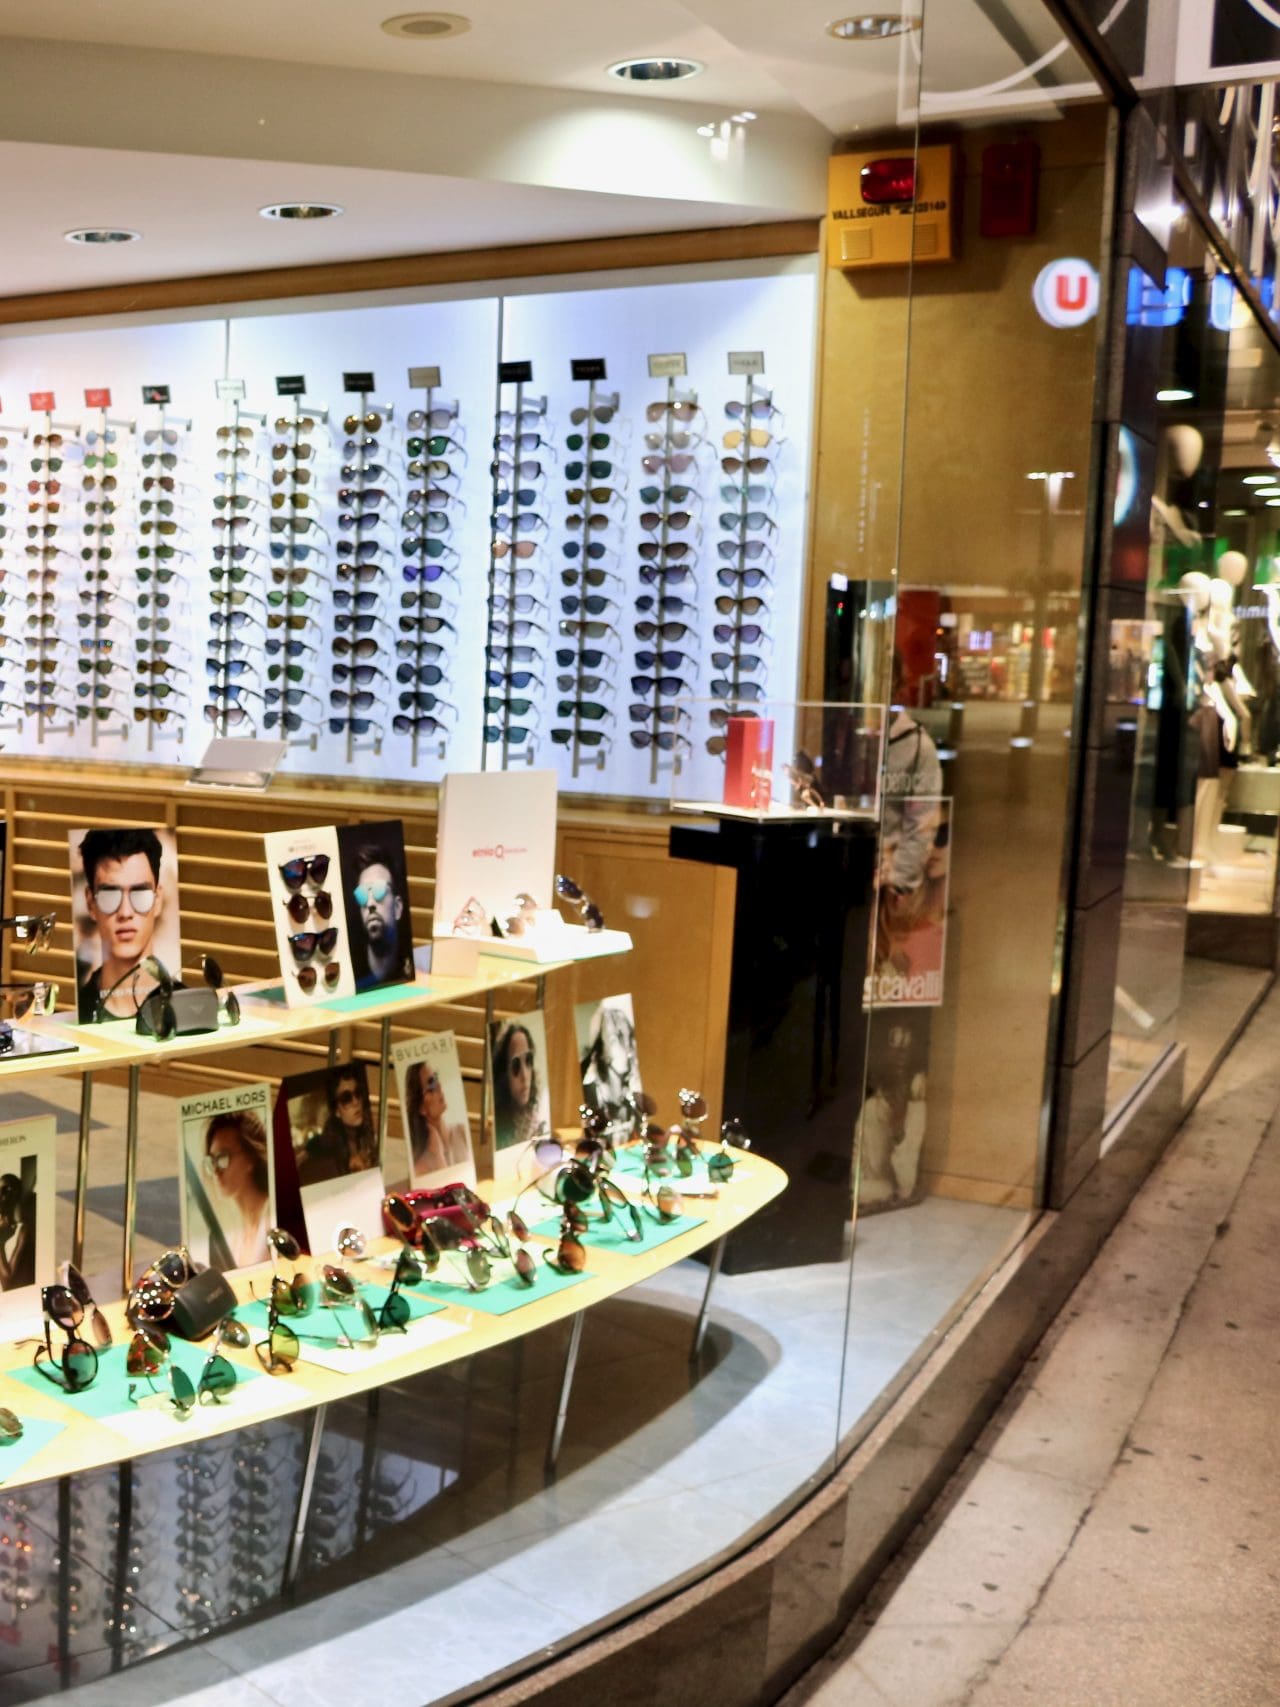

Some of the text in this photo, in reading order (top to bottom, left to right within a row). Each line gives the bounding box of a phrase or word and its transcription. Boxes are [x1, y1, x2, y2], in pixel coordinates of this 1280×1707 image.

[395, 1036, 454, 1063] BVLGARI
[181, 1090, 268, 1118] MICHAEL KORS
